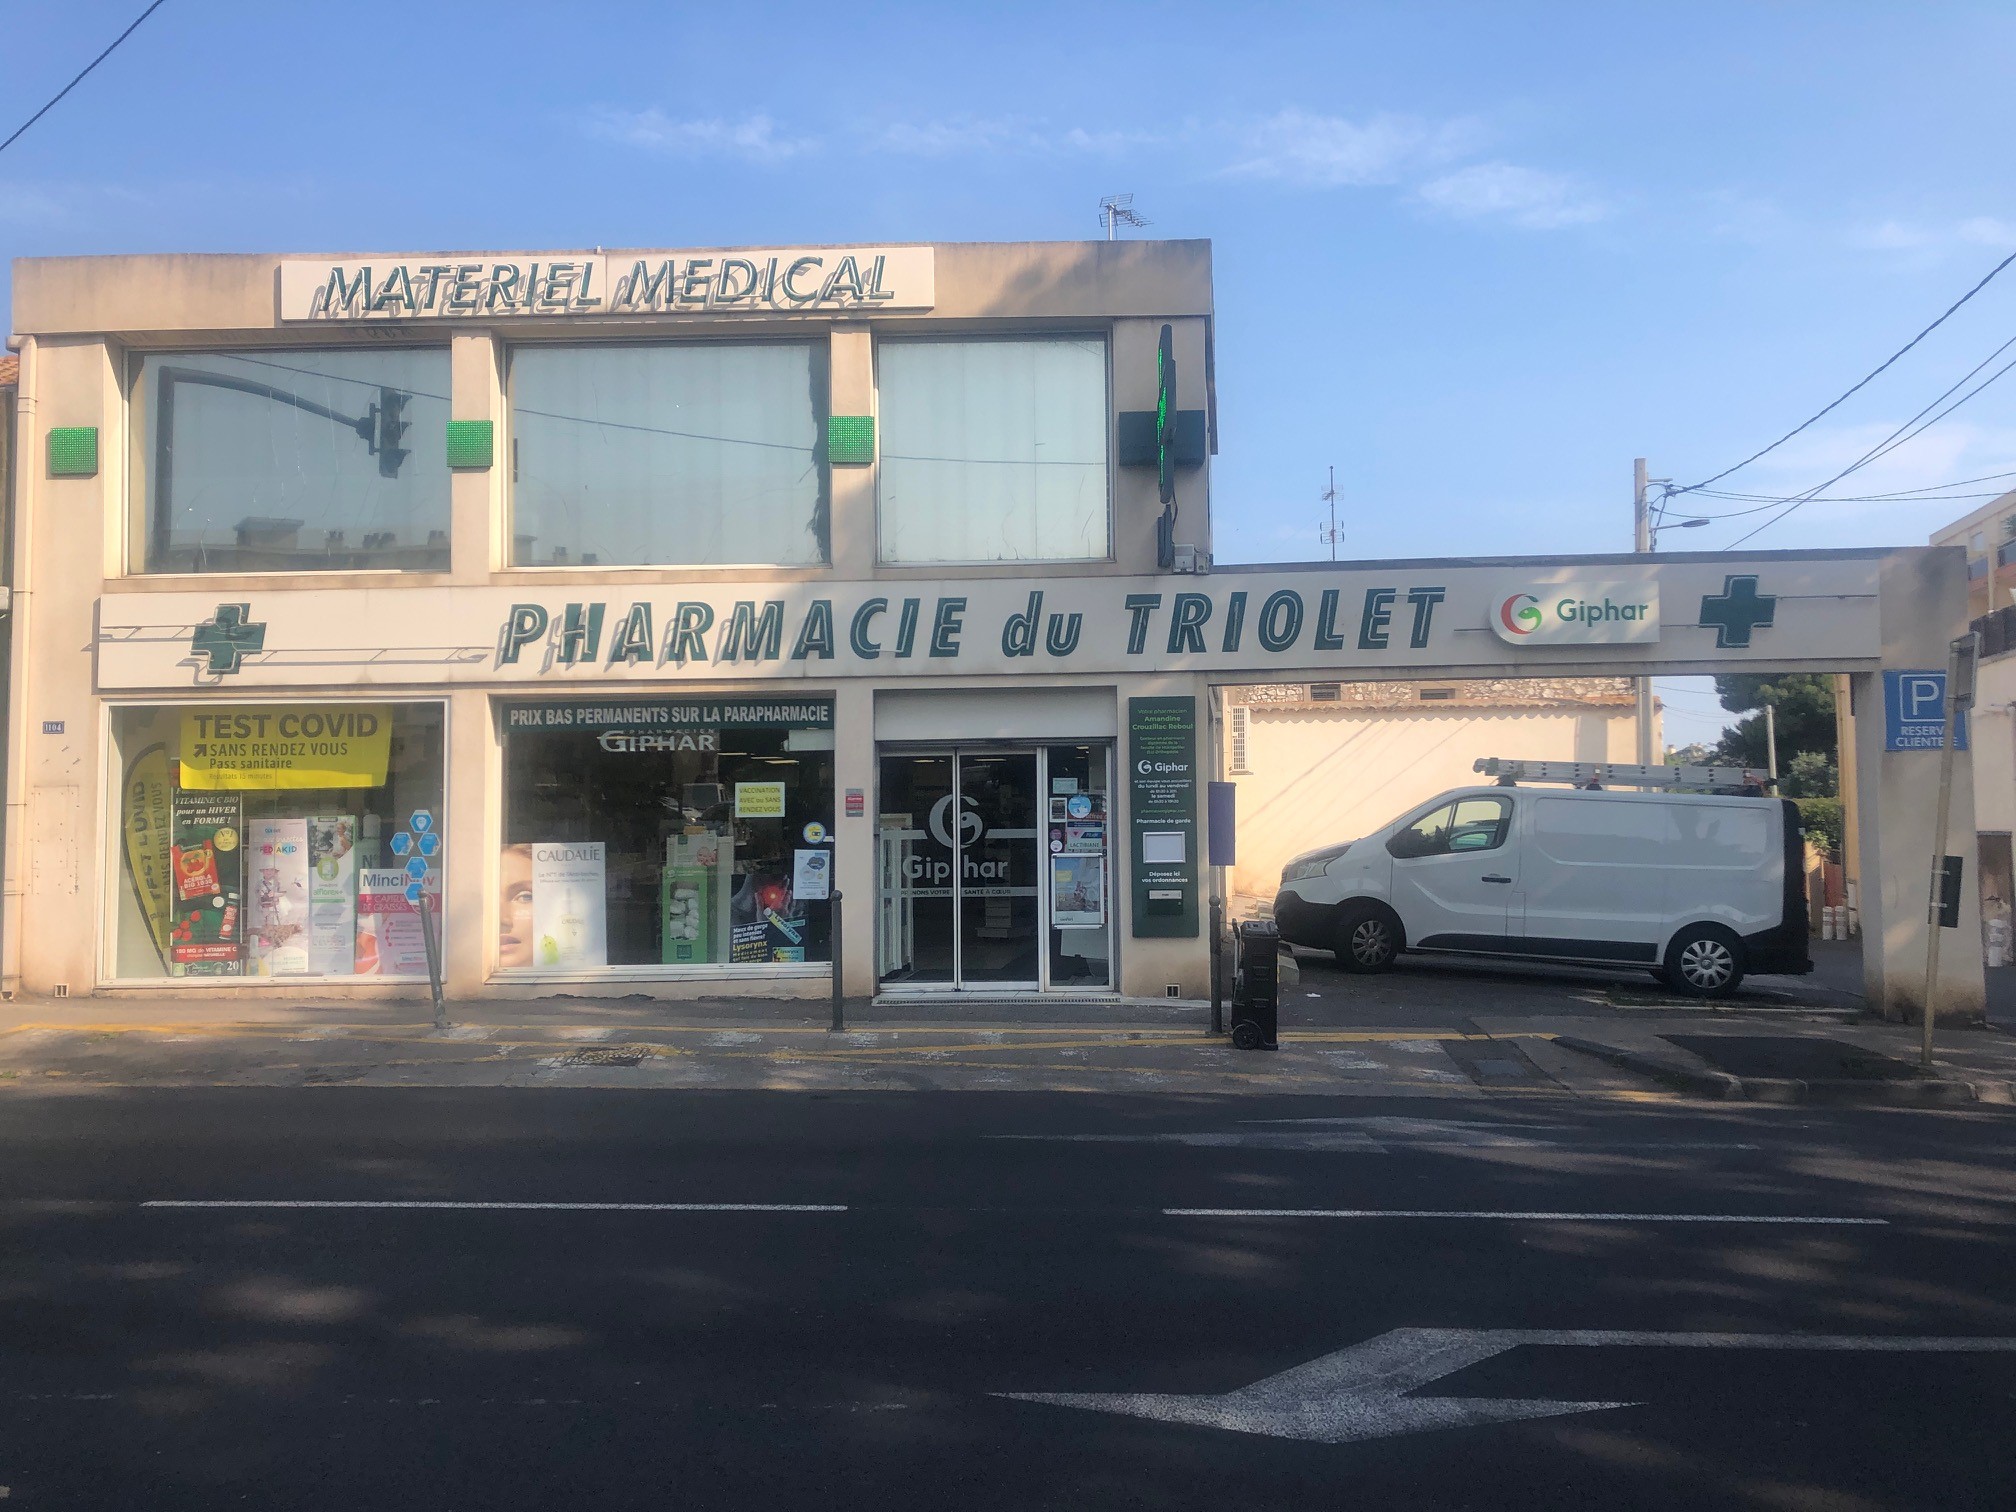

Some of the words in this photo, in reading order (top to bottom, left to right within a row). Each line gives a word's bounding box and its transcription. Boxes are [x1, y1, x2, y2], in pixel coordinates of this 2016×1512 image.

[321, 261, 602, 311] MATERIEL
[623, 254, 895, 304] MEDICAL
[1556, 597, 1649, 628] Giphar
[499, 597, 967, 664] PHARMACIE
[1001, 590, 1082, 657] du
[1125, 586, 1446, 655] TRIOLET
[1911, 680, 1940, 716] P
[510, 708, 543, 726] PRIX
[545, 708, 573, 725] BAS
[576, 706, 668, 724] PERMANENTS
[671, 706, 700, 723] SUR
[703, 706, 721, 723] LA
[724, 704, 829, 722] PARAPHARMACIE
[193, 713, 272, 739] TEST
[278, 712, 379, 739] COVID
[1901, 725, 1945, 736] RESERV
[600, 730, 720, 753] GIPHAR
[1895, 736, 1958, 747] CLIENTEE
[209, 743, 247, 757] SANS
[251, 742, 306, 756] RENDEZ
[310, 742, 348, 756] VOUS
[209, 758, 237, 770] Pass
[241, 757, 293, 769] sanitaire
[1154, 762, 1189, 774] Giphar
[176, 808, 195, 816] pour
[208, 806, 237, 814] HIVER
[732, 940, 768, 952] Lysorynx
[226, 961, 240, 971] 20
